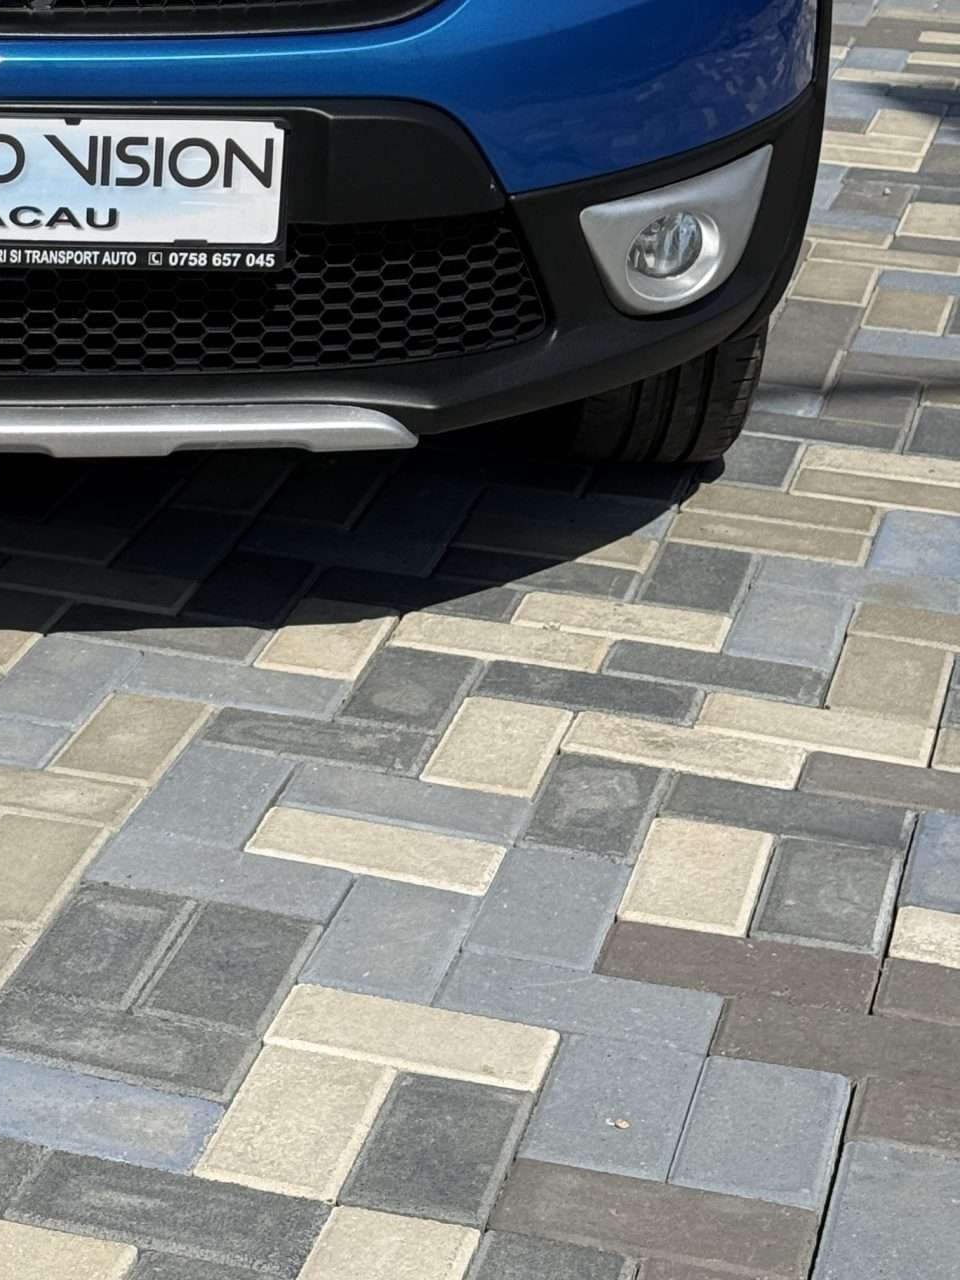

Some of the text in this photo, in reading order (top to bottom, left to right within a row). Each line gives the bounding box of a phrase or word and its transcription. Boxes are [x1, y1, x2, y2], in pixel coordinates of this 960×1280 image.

[43, 134, 274, 188] VISION
[9, 249, 22, 264] SI
[24, 249, 100, 265] TRANSPORT
[101, 251, 137, 266] AUTO
[168, 252, 208, 267] 0758
[212, 252, 242, 267] 657
[245, 253, 276, 268] 045
